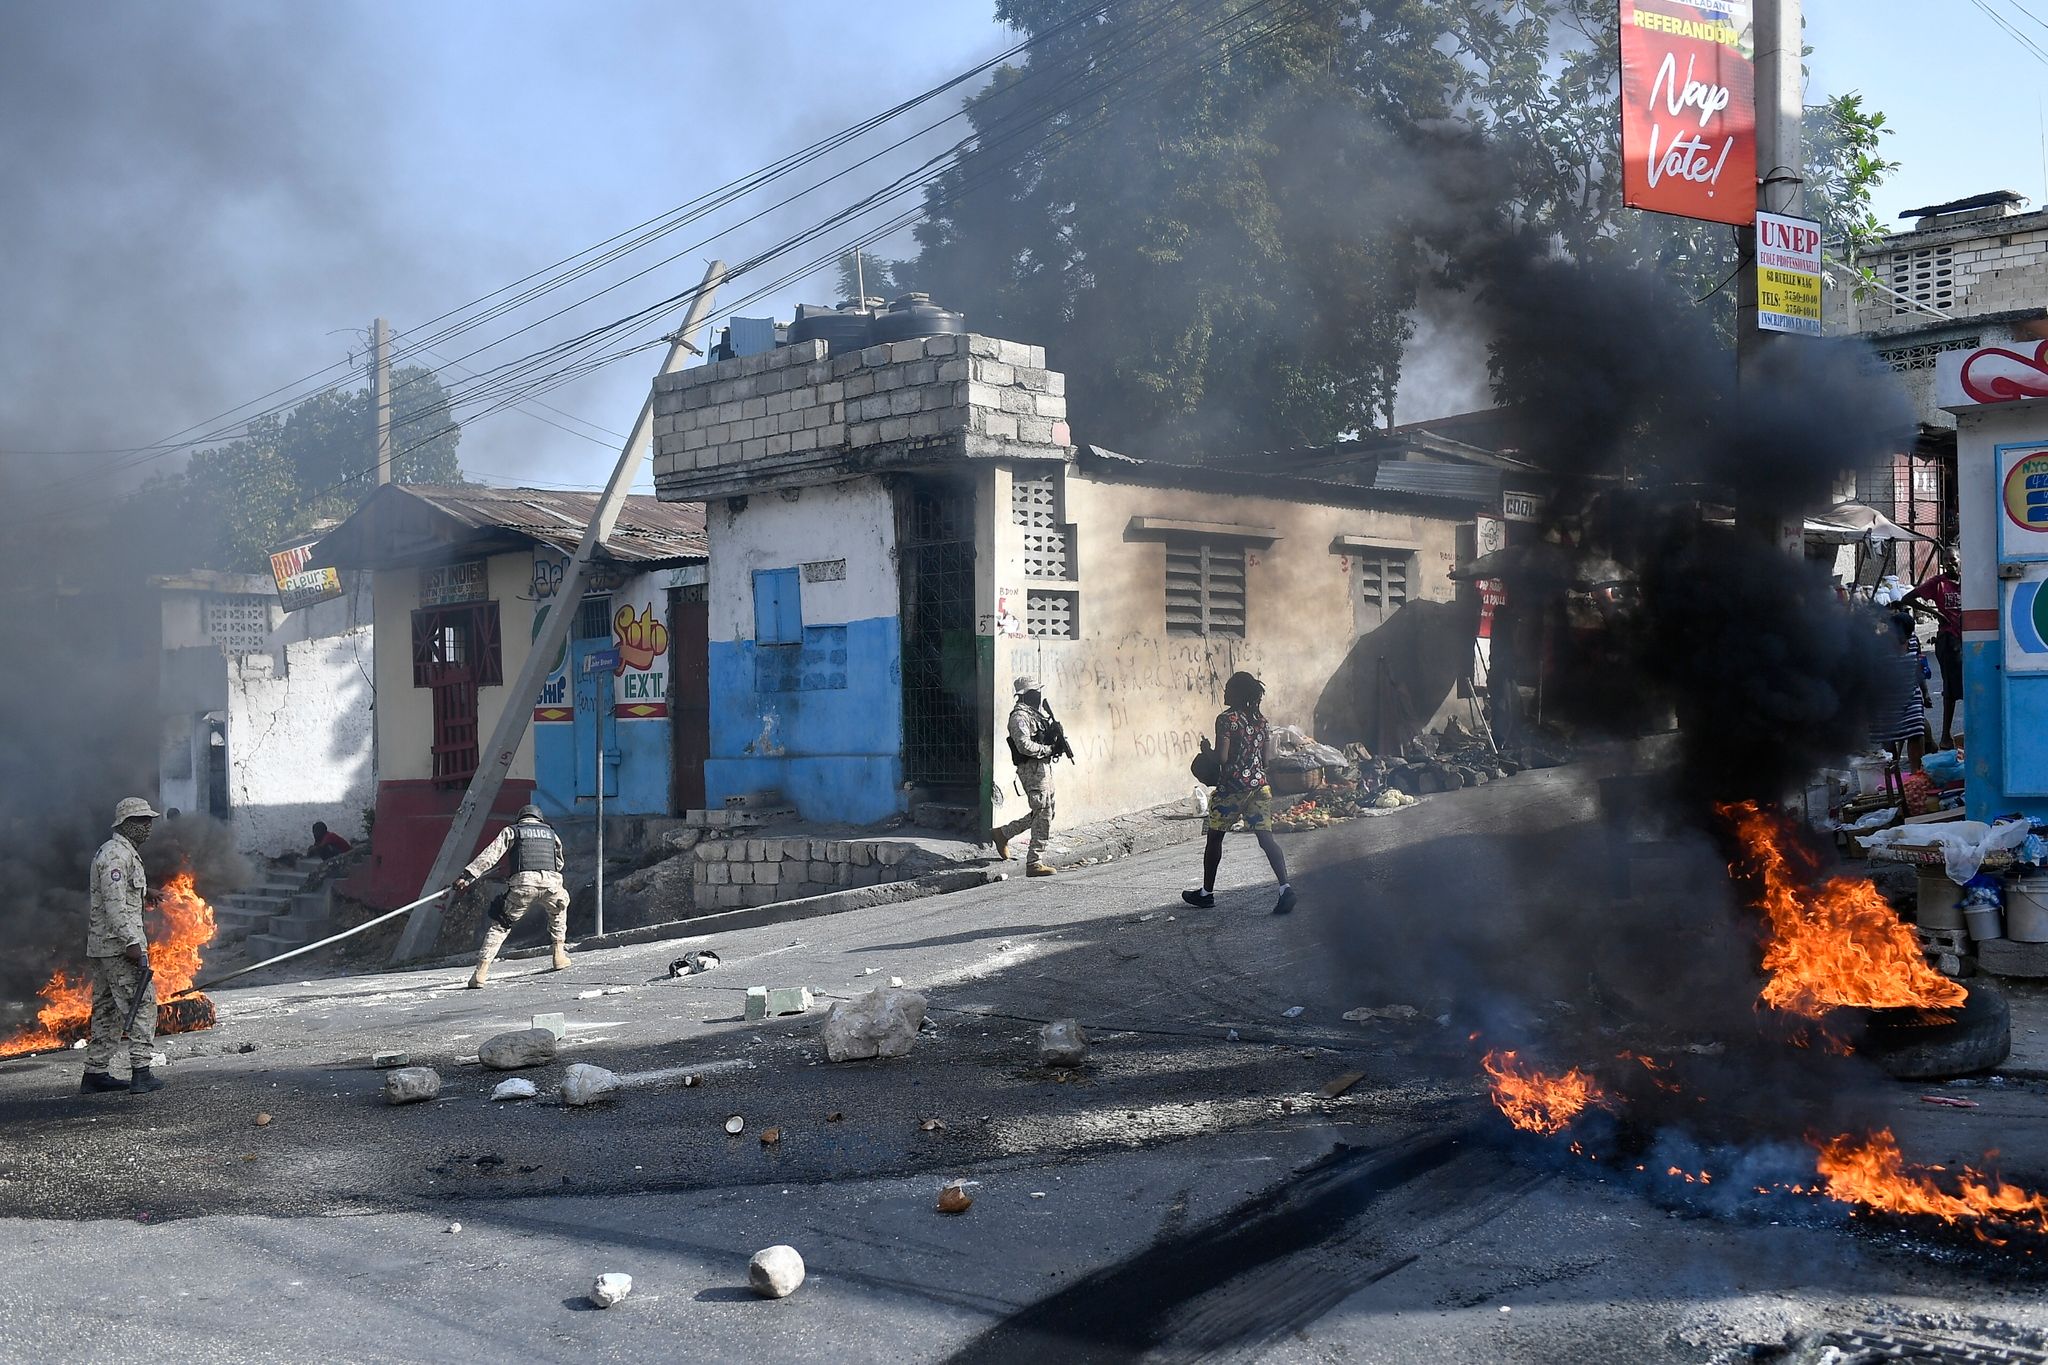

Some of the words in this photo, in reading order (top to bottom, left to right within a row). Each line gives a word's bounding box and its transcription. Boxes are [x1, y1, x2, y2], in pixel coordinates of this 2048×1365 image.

[1633, 9, 1739, 46] REFERANDOM
[1650, 52, 1729, 127] Nap
[1648, 123, 1734, 197] Vote!
[1760, 220, 1819, 254] UNEP
[1760, 251, 1775, 267] ECOLE
[1762, 291, 1780, 307] TELS:
[1761, 312, 1794, 329] INSCRIPTION
[520, 828, 552, 839] POLICE
